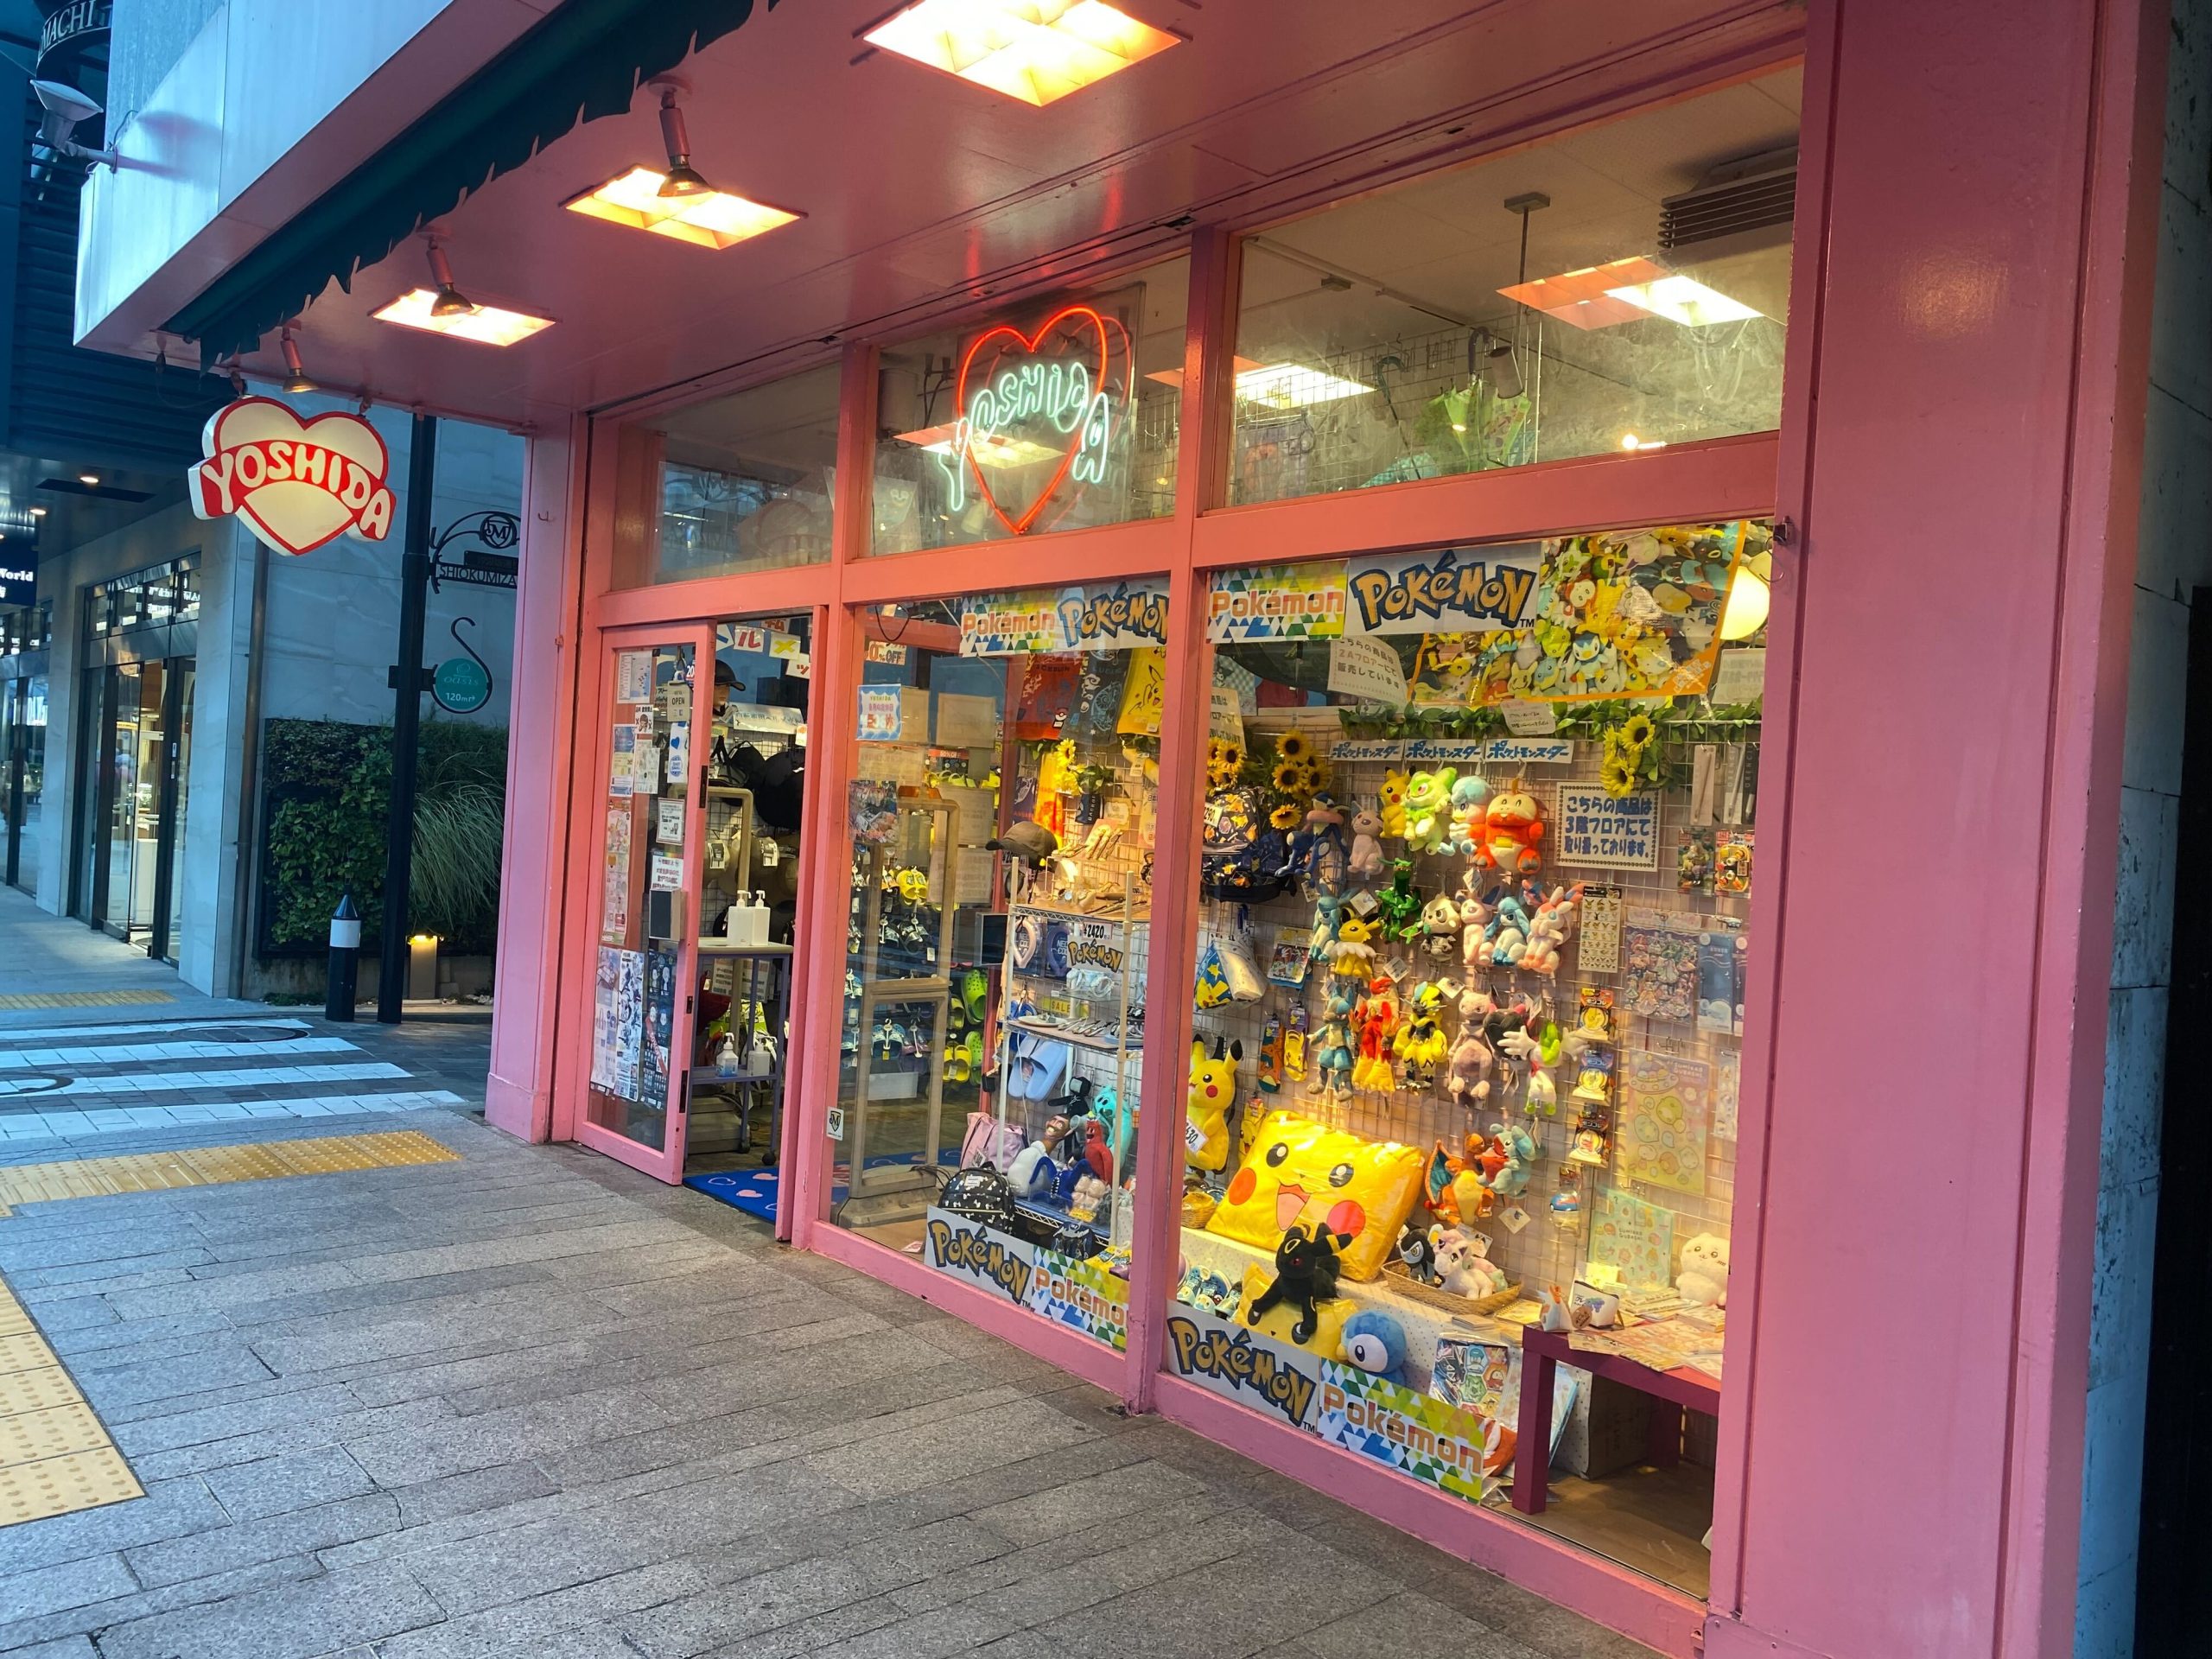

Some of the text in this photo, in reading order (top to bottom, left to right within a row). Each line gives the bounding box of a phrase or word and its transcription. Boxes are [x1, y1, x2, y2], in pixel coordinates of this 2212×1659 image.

[936, 361, 1110, 512] YOSHIDA
[200, 442, 391, 540] YOSHIDA
[1211, 590, 1344, 619] Pokémon
[963, 610, 1056, 635] Pokémon
[671, 697, 685, 706] OPEN
[1567, 795, 1652, 816] こちらの商品は
[1565, 816, 1651, 836] 3階フロアにて
[1564, 836, 1649, 858] 取り扱っております。
[1051, 1001, 1071, 1014] SALE
[1324, 1383, 1483, 1474] Pokémon
